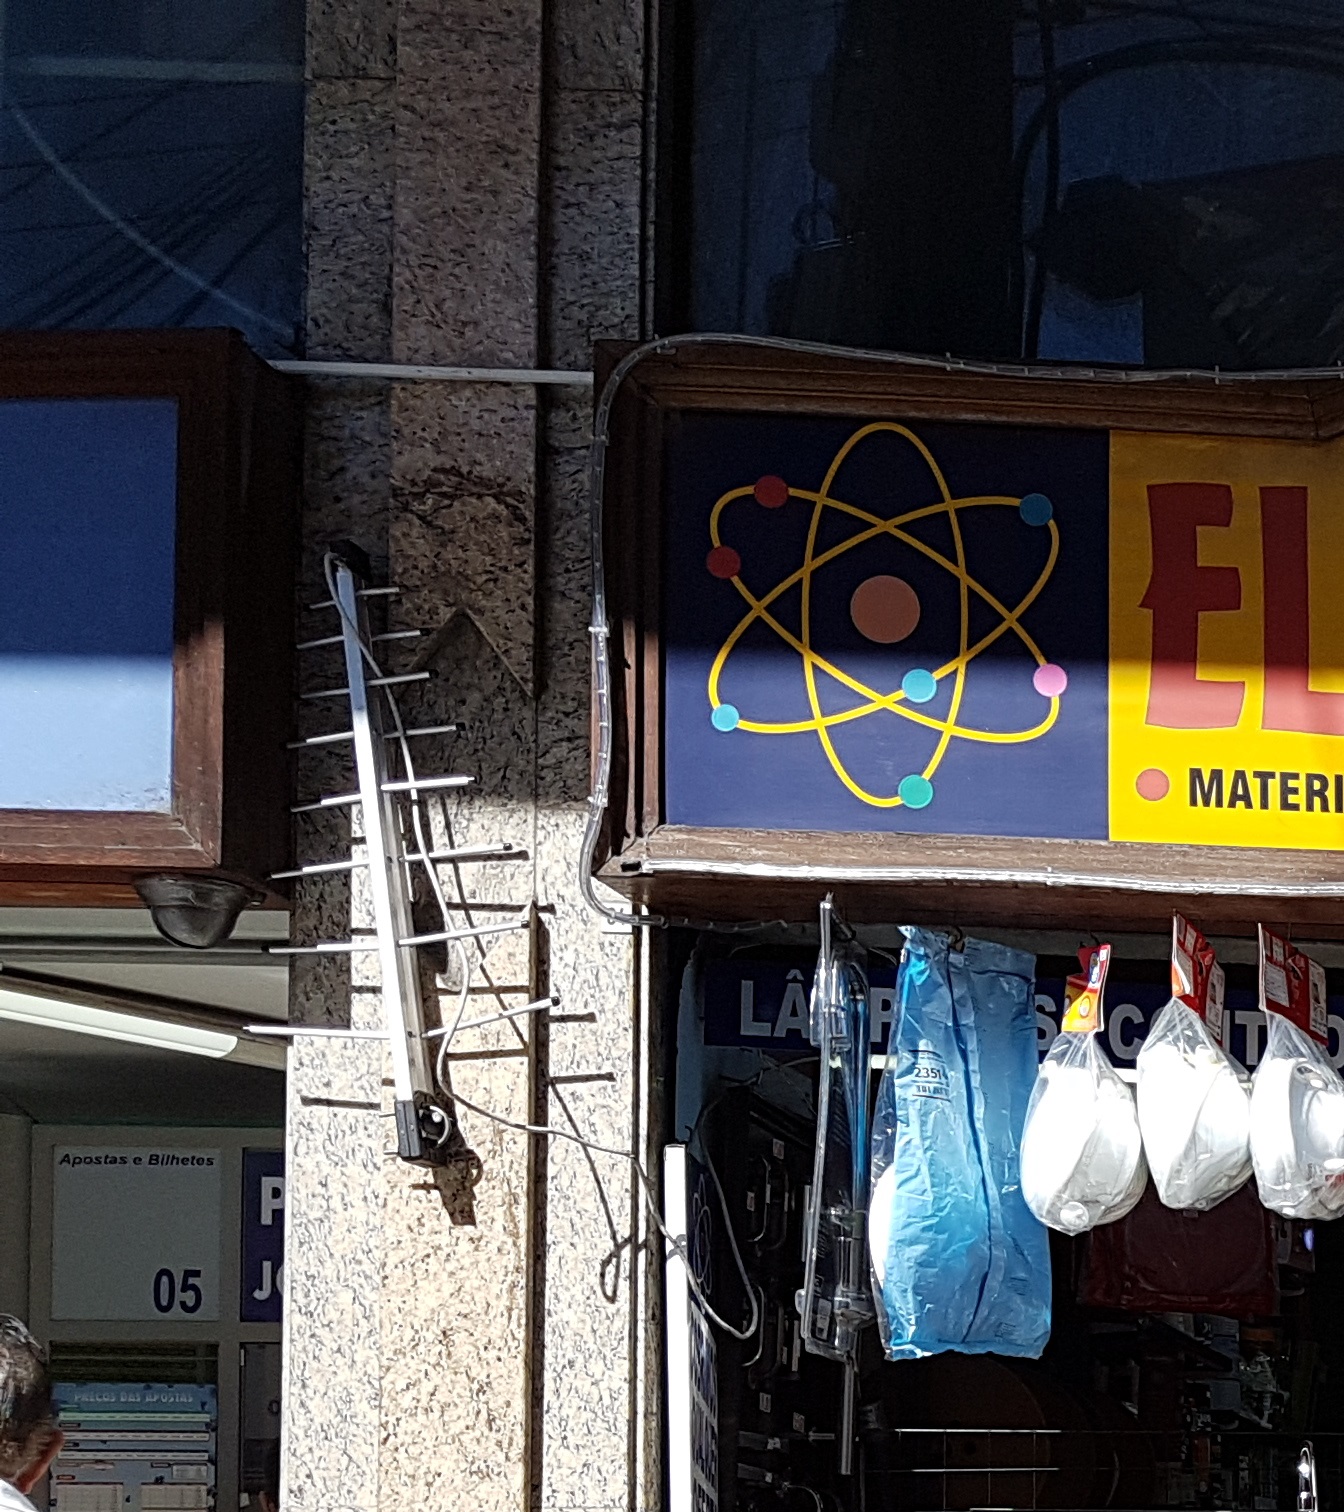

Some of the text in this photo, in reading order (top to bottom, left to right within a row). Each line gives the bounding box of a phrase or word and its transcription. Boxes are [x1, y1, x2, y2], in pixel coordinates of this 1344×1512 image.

[59, 1153, 127, 1168] Apostas
[148, 1154, 214, 1167] Bilhetes
[153, 1268, 203, 1314] 05
